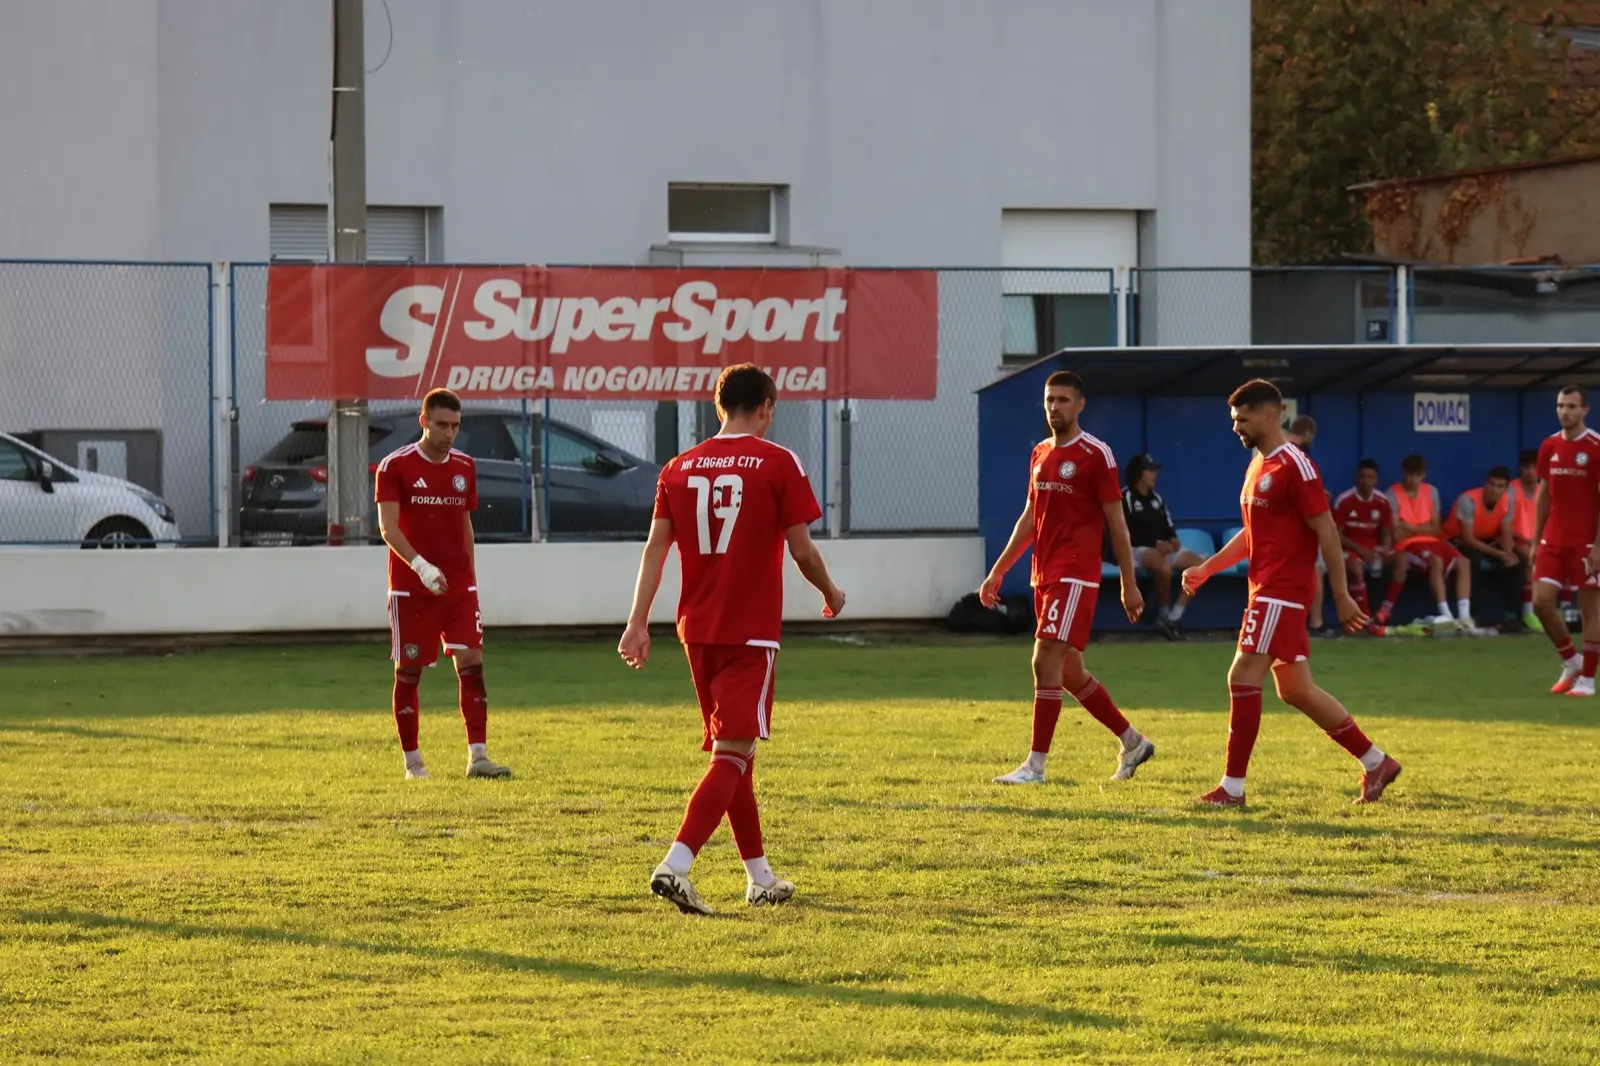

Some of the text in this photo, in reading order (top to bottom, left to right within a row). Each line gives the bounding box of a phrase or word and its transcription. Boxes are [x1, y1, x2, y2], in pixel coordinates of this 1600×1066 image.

[463, 278, 847, 354] SuperSport
[446, 366, 554, 391] DRUGA
[563, 366, 723, 391] NOGOMET
[696, 456, 735, 468] ZAGREB
[737, 456, 764, 469] CITY
[687, 474, 743, 555] 19
[1047, 599, 1060, 621] 6
[1246, 609, 1260, 633] 5
